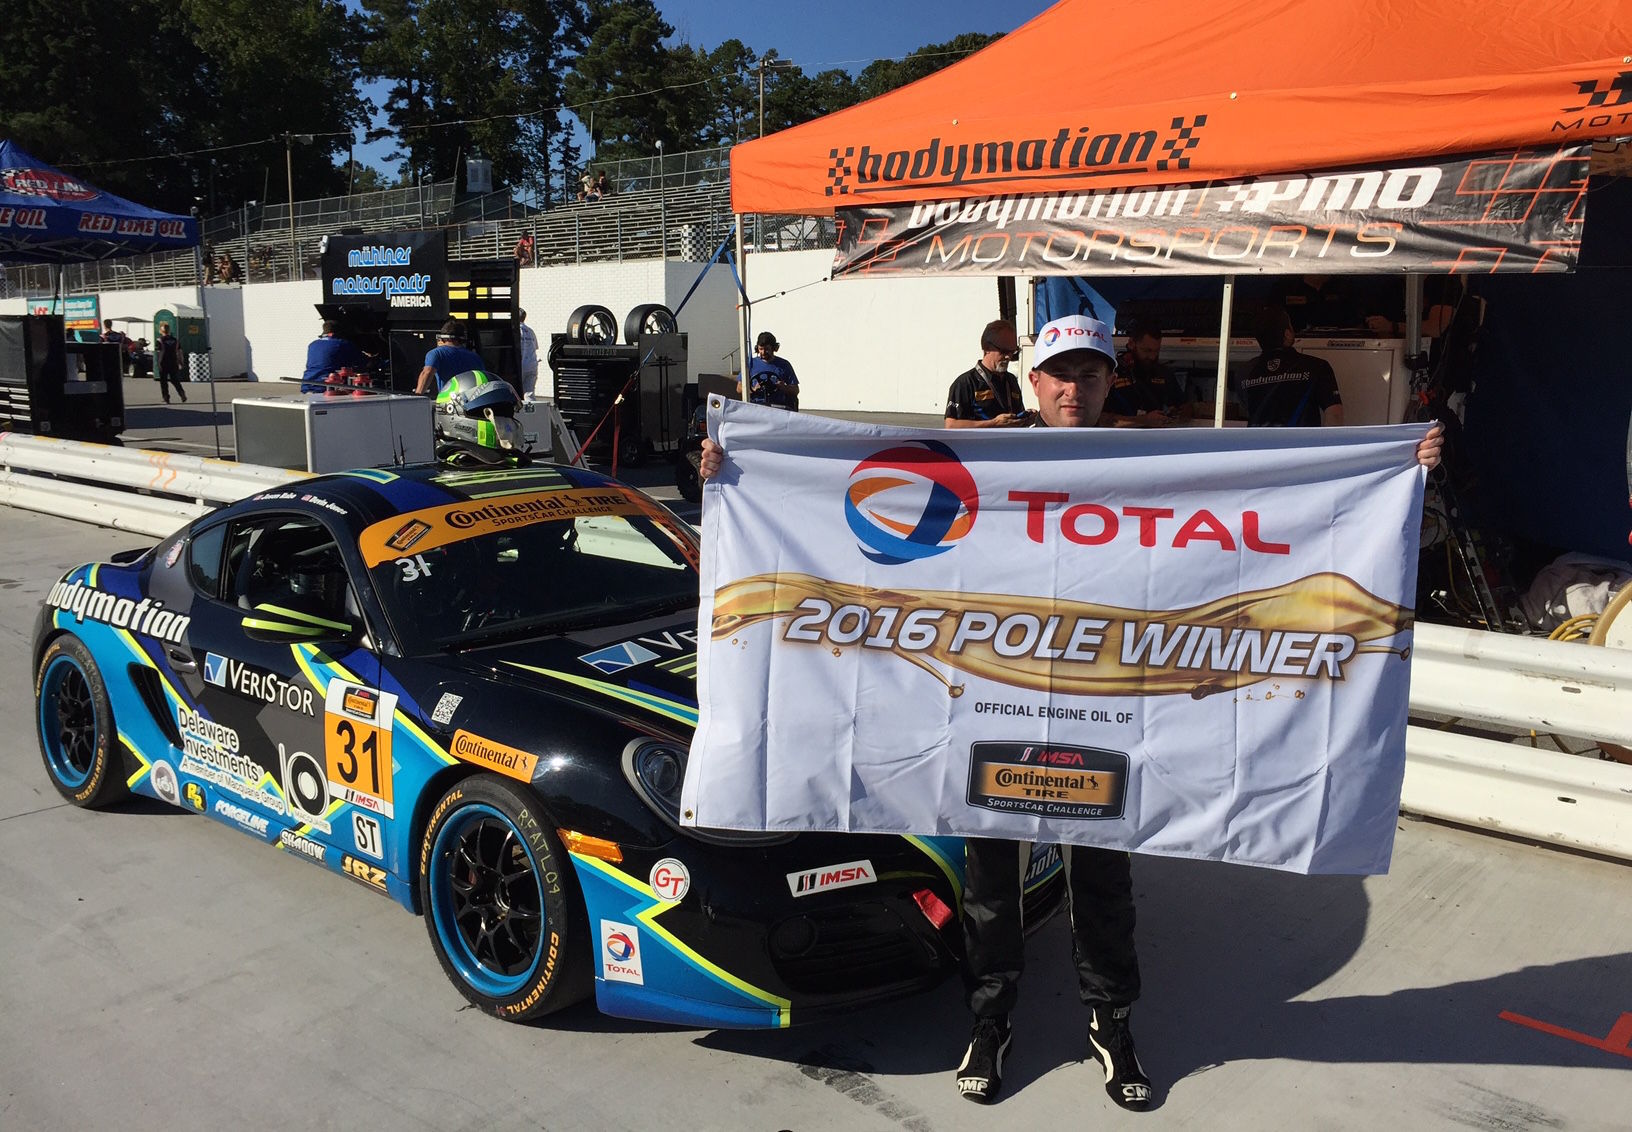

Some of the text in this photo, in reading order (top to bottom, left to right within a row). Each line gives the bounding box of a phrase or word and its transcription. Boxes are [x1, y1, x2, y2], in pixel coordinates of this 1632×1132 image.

[857, 127, 1158, 184] bodymotion
[16, 207, 48, 229] OIL
[78, 212, 187, 239] RED LINE OIL
[925, 222, 1404, 264] MOTORSPORTS
[333, 273, 431, 300] motorsports
[391, 295, 432, 307] AMERICA
[1065, 327, 1107, 343] TOTAL
[1245, 371, 1303, 387] bodymotion
[445, 495, 626, 529] Continental TIRE
[1008, 490, 1291, 555] TOTAL
[395, 554, 432, 582] 31
[46, 578, 191, 643] bodymotion
[784, 597, 1356, 680] 2016 POLE WINNER
[178, 707, 239, 749] Delaware
[974, 702, 1134, 724] OFFICIAL ENGINE OIL OF
[180, 732, 260, 783] Investments
[336, 719, 380, 795] 31
[455, 734, 519, 770] Continental
[1037, 750, 1085, 766] IMSA
[995, 768, 1084, 790] Continental
[1022, 787, 1069, 799] TIRE
[215, 800, 269, 834] FORGELINE
[355, 795, 380, 811] IMSA
[281, 830, 325, 860] SHADOW
[356, 815, 378, 853] ST
[421, 789, 464, 876] CONTINENTAL
[342, 855, 388, 889] JRZ
[655, 867, 685, 897] GT
[820, 867, 869, 886] IMSA
[506, 931, 559, 1015] CONTINENTAL
[605, 963, 640, 977] TOTAL
[1122, 1086, 1151, 1099] OM
